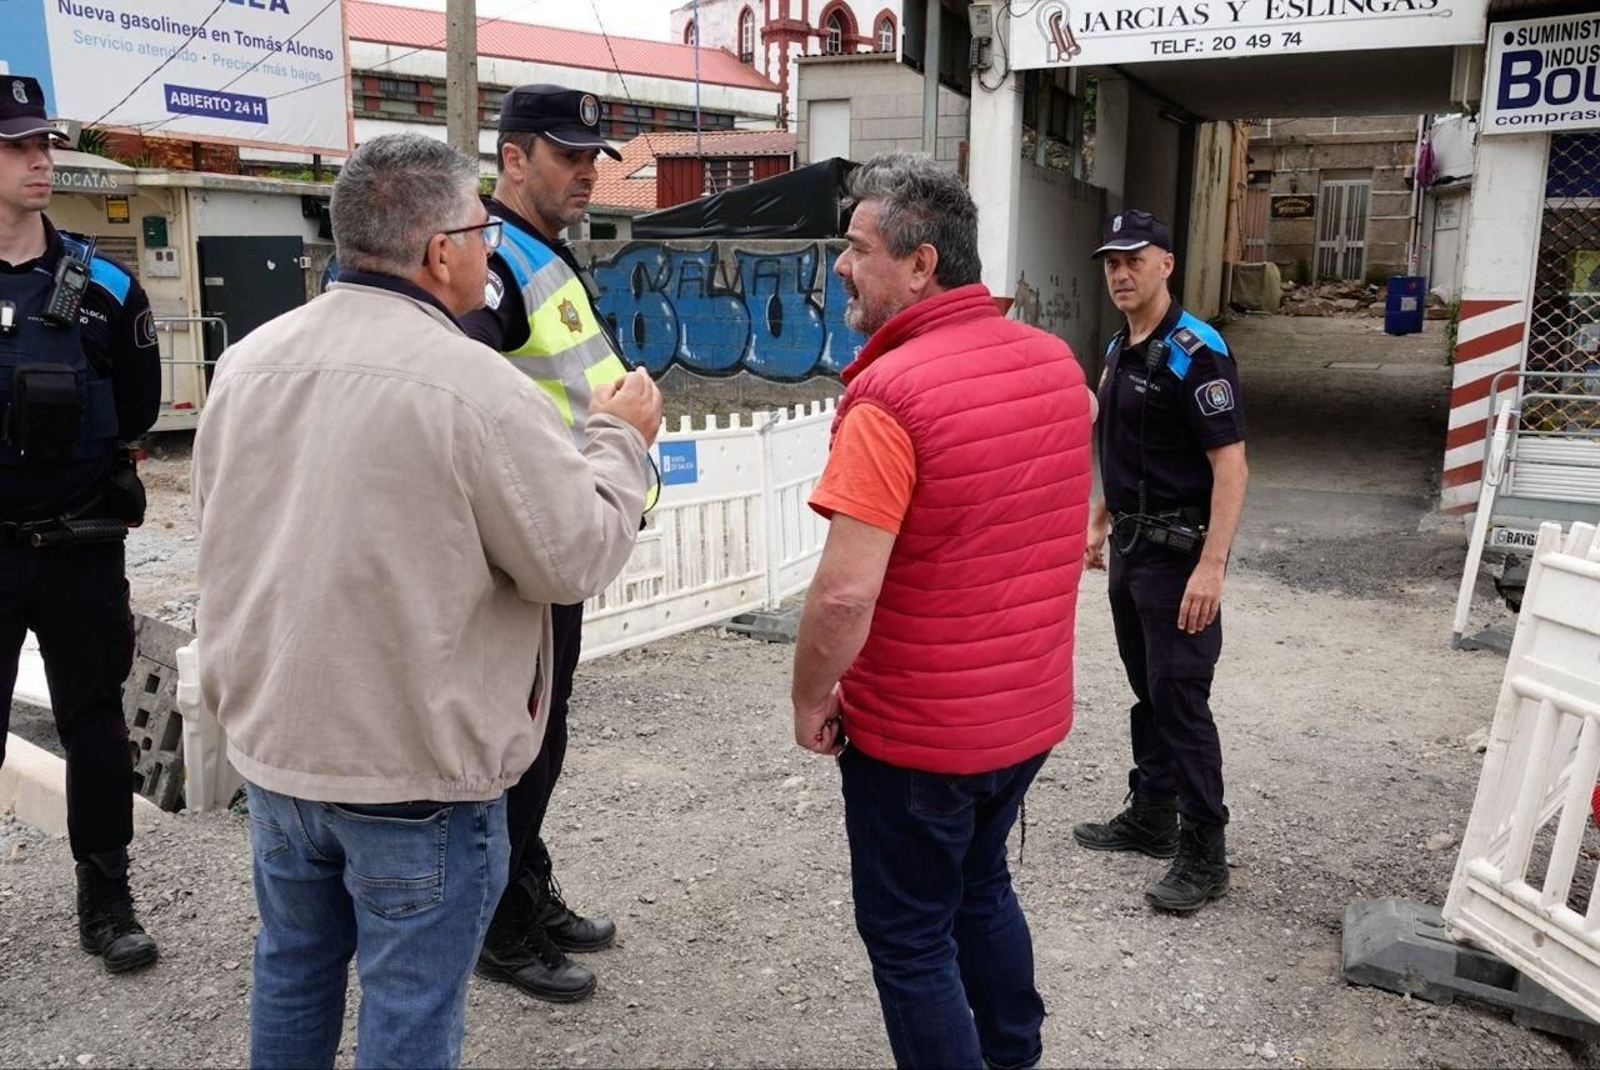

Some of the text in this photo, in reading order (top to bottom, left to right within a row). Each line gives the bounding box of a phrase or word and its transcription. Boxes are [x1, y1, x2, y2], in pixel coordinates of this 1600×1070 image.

[1079, 0, 1439, 34] JARCIAS Y ESLINGAS
[58, 0, 334, 61] Nueva gasolinera en Tomás Alonso
[1150, 31, 1303, 55] TELF.: 20 49 74
[73, 29, 322, 84] Servicio atendido Precios más bajos
[1544, 44, 1600, 69] INDUS
[170, 91, 264, 116] ABIERTO 24 H
[1495, 109, 1600, 126] compras
[53, 171, 118, 189] BOCATAS
[1506, 531, 1538, 546] BAYG
